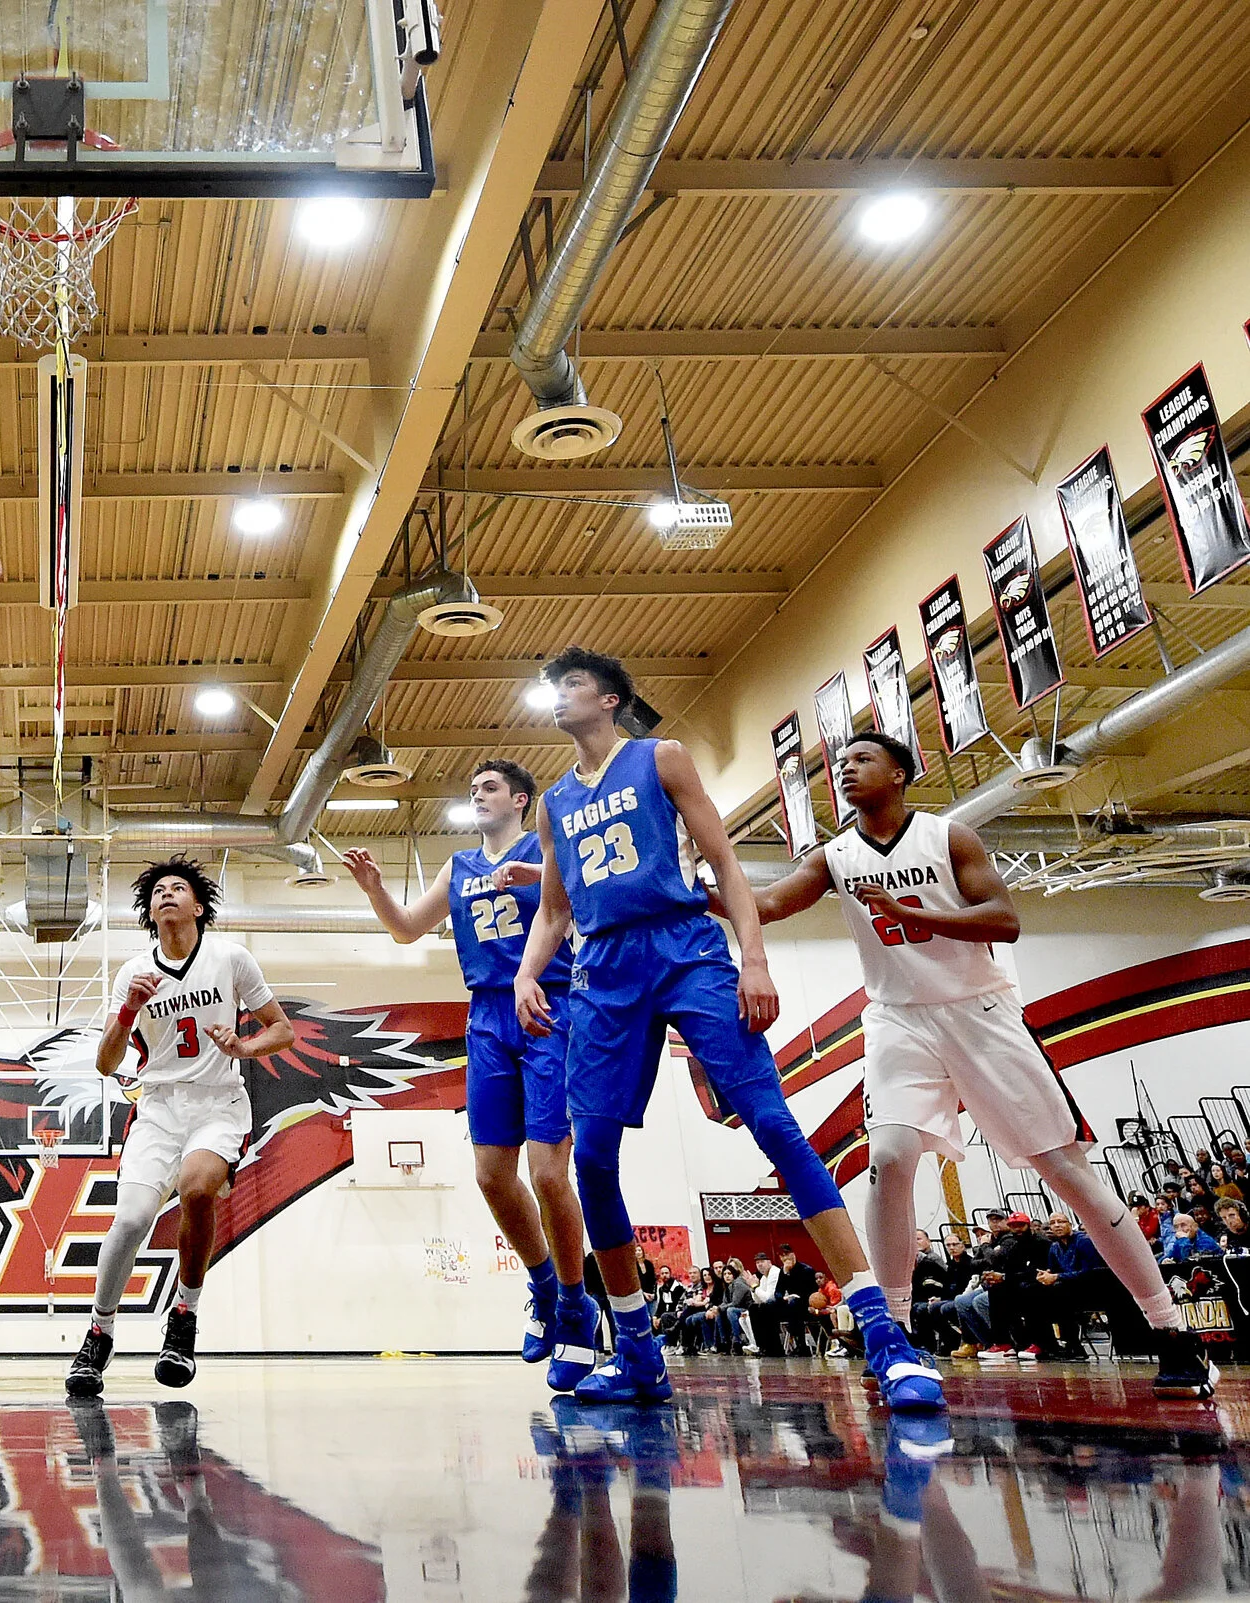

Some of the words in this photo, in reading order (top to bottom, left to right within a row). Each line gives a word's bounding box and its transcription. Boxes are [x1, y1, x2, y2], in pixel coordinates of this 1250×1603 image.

[1154, 395, 1209, 449] CHAMPIONS
[1159, 385, 1193, 424] LEAGUE
[1069, 464, 1099, 497] LEAGUE
[995, 533, 1020, 562] LEAGUE
[926, 600, 961, 636] CHAMPIONS
[929, 590, 951, 617] LEAGUE
[1014, 605, 1032, 626] BOYS
[561, 786, 638, 839] EAGLES
[578, 821, 639, 888] 23
[471, 893, 524, 943] 22
[146, 987, 223, 1020] ETIWANDA
[176, 1016, 200, 1058] 3
